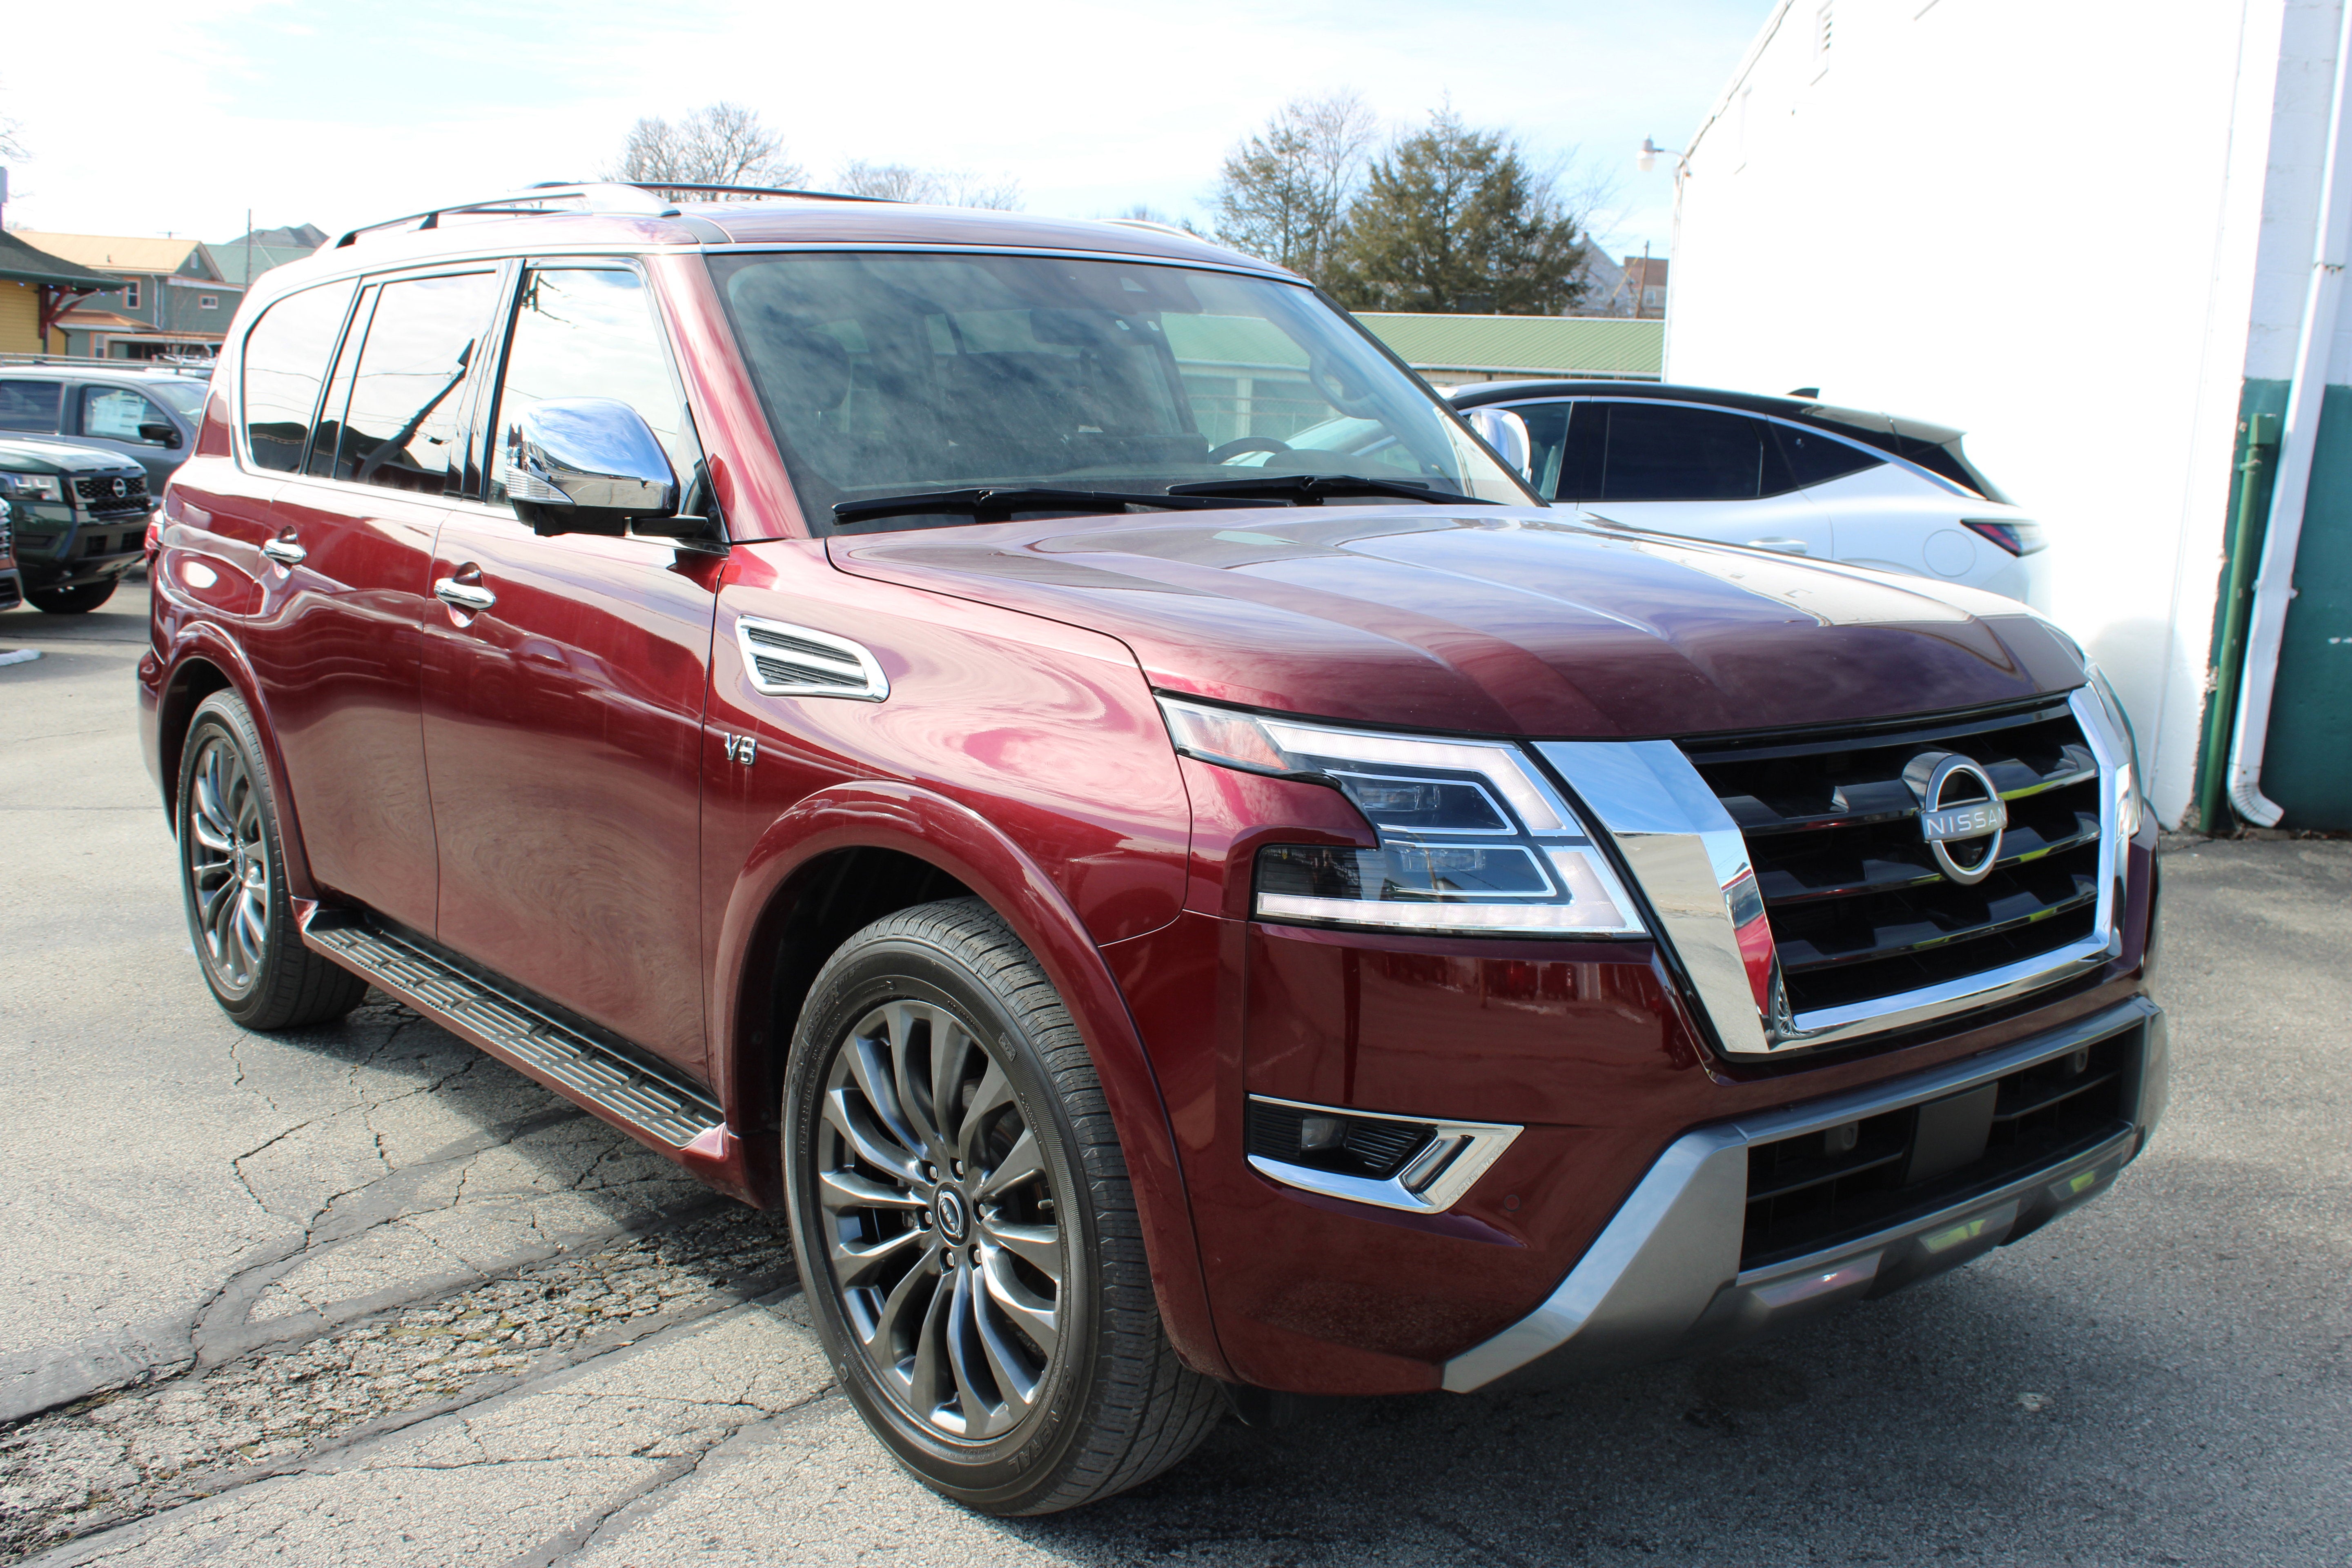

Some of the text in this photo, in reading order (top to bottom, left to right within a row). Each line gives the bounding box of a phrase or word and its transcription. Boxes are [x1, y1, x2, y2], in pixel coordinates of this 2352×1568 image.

[724, 732, 757, 765] V8
[1926, 807, 2007, 835] NISSAN
[938, 1189, 962, 1239] NISSAN
[1007, 1371, 1074, 1474] GENERAL
